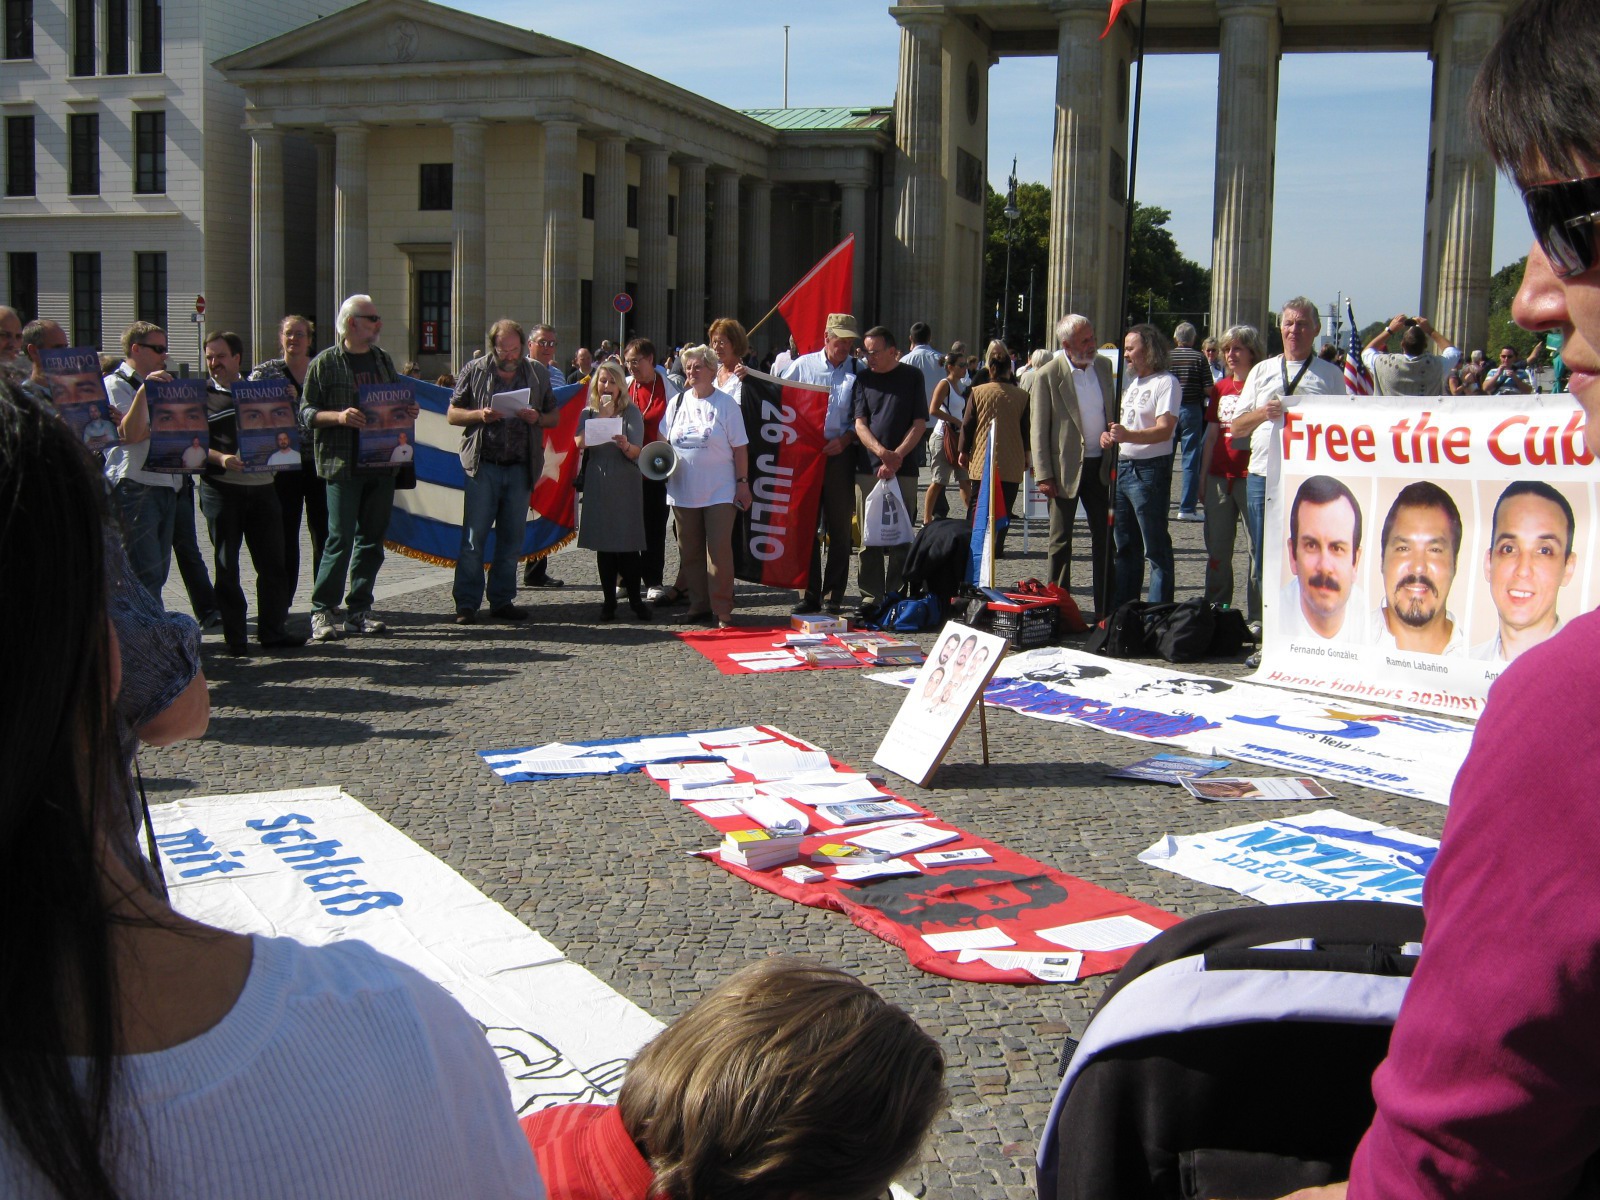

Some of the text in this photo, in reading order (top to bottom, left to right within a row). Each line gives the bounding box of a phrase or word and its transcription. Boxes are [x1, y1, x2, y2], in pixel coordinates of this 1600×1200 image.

[45, 354, 96, 369] GERARDO
[157, 384, 198, 399] RAMÓN
[365, 389, 412, 402] ANTONIO
[1282, 411, 1376, 464] Free
[1388, 411, 1471, 465] the
[749, 399, 797, 561] 26 JULIO
[1290, 644, 1326, 657] Fernando
[1385, 656, 1449, 674] Ramón Labañino
[1266, 670, 1328, 688] Heroic
[1329, 677, 1403, 700] fighters
[1407, 690, 1479, 712] against
[1318, 735, 1352, 750] Held
[154, 827, 247, 880] mit
